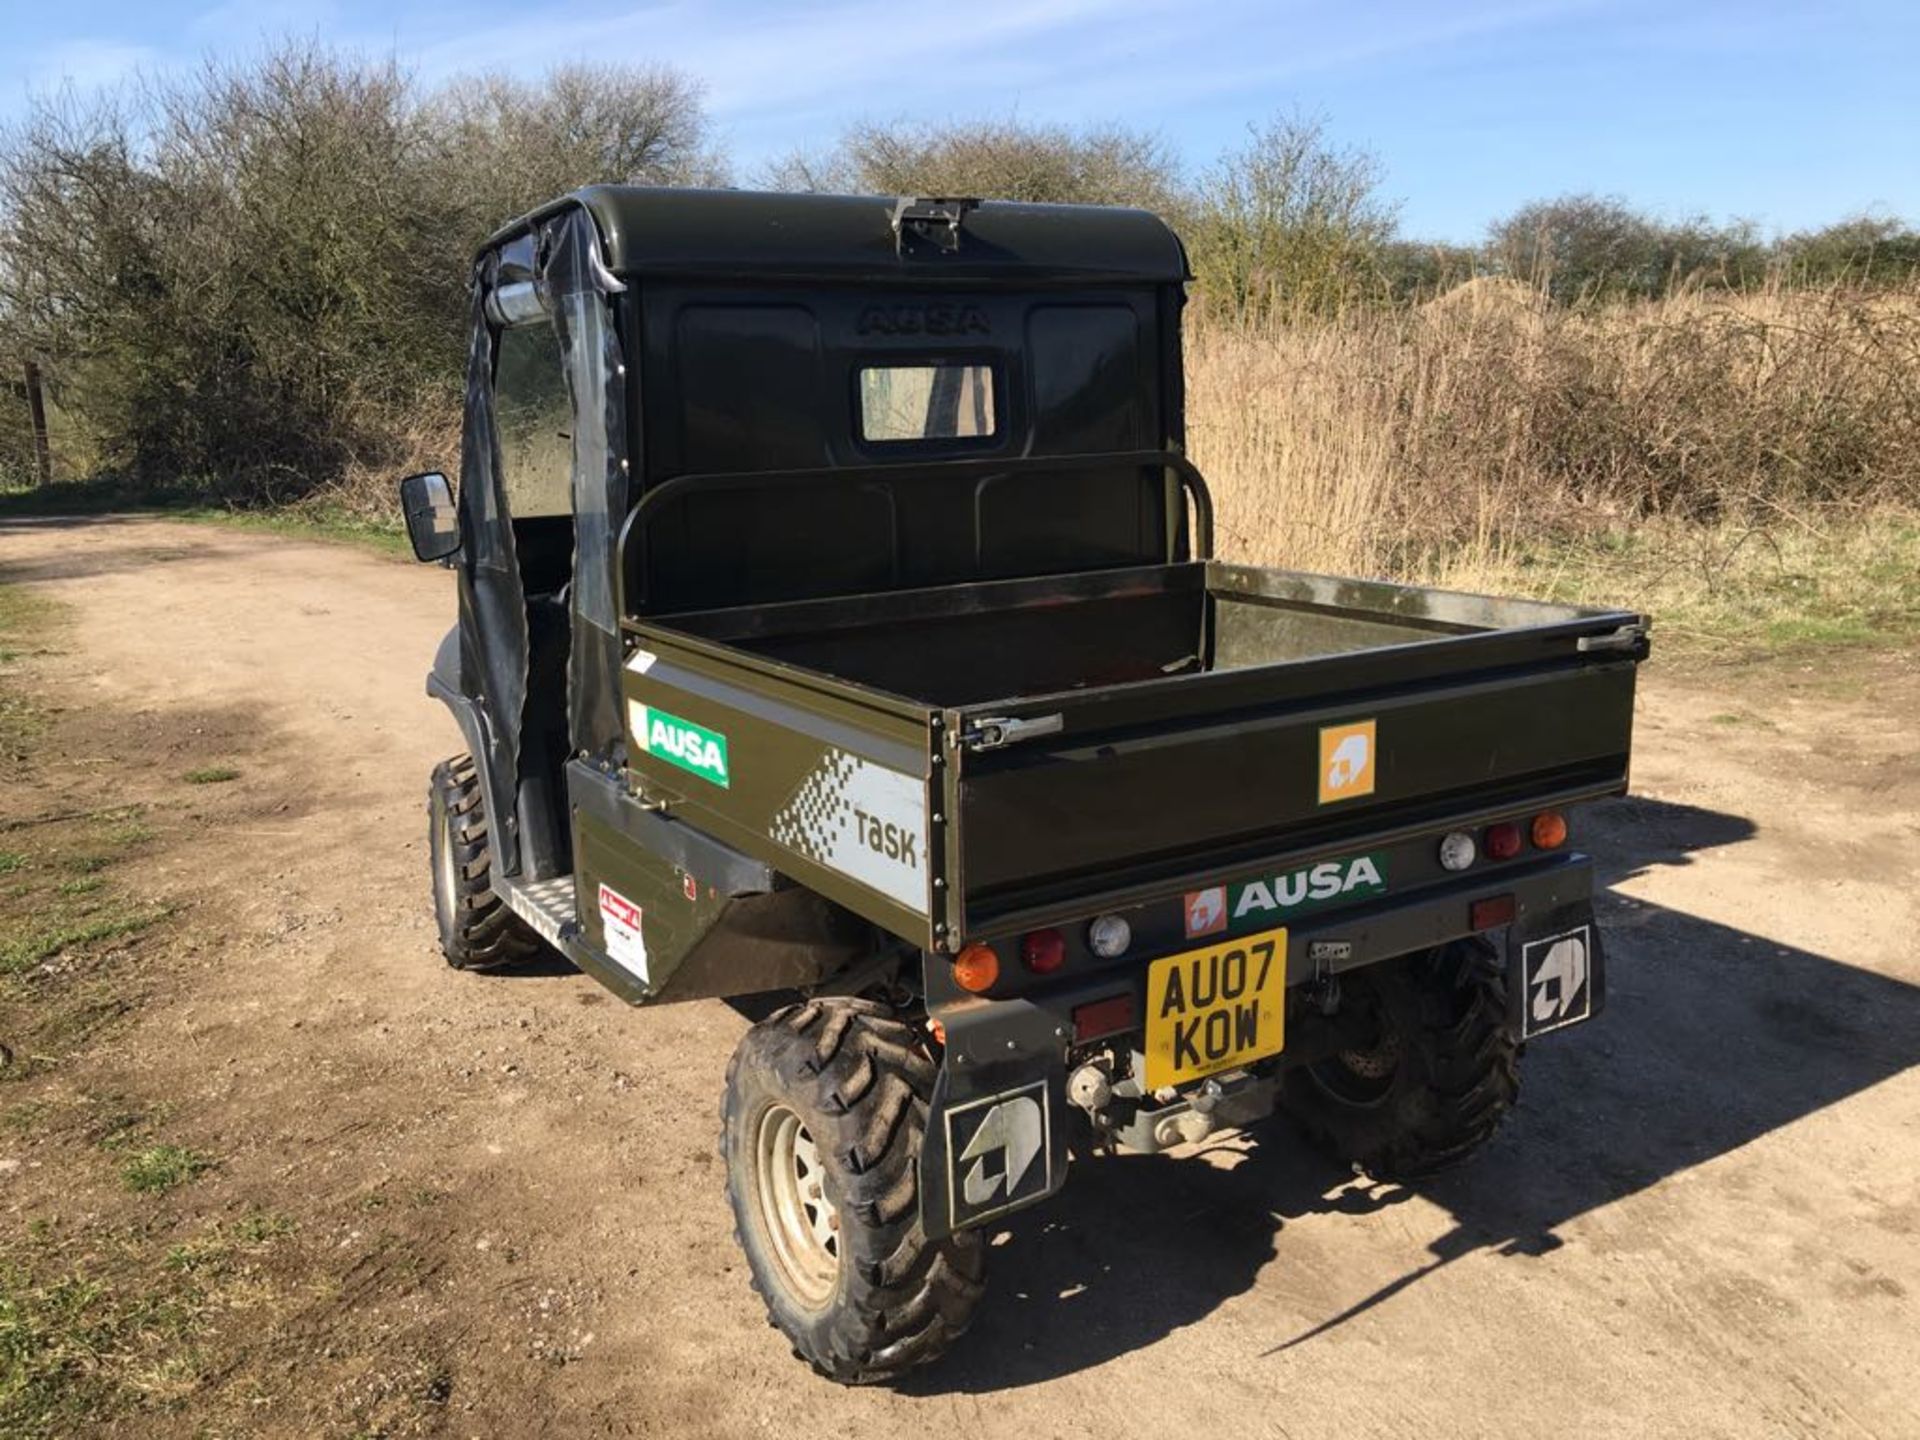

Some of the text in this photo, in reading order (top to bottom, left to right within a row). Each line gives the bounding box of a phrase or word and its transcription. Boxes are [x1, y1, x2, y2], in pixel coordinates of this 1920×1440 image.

[650, 719, 725, 776] AUSA
[1233, 856, 1382, 918] AUSA
[1160, 939, 1276, 1019] AU07
[1174, 999, 1259, 1071] KOW
